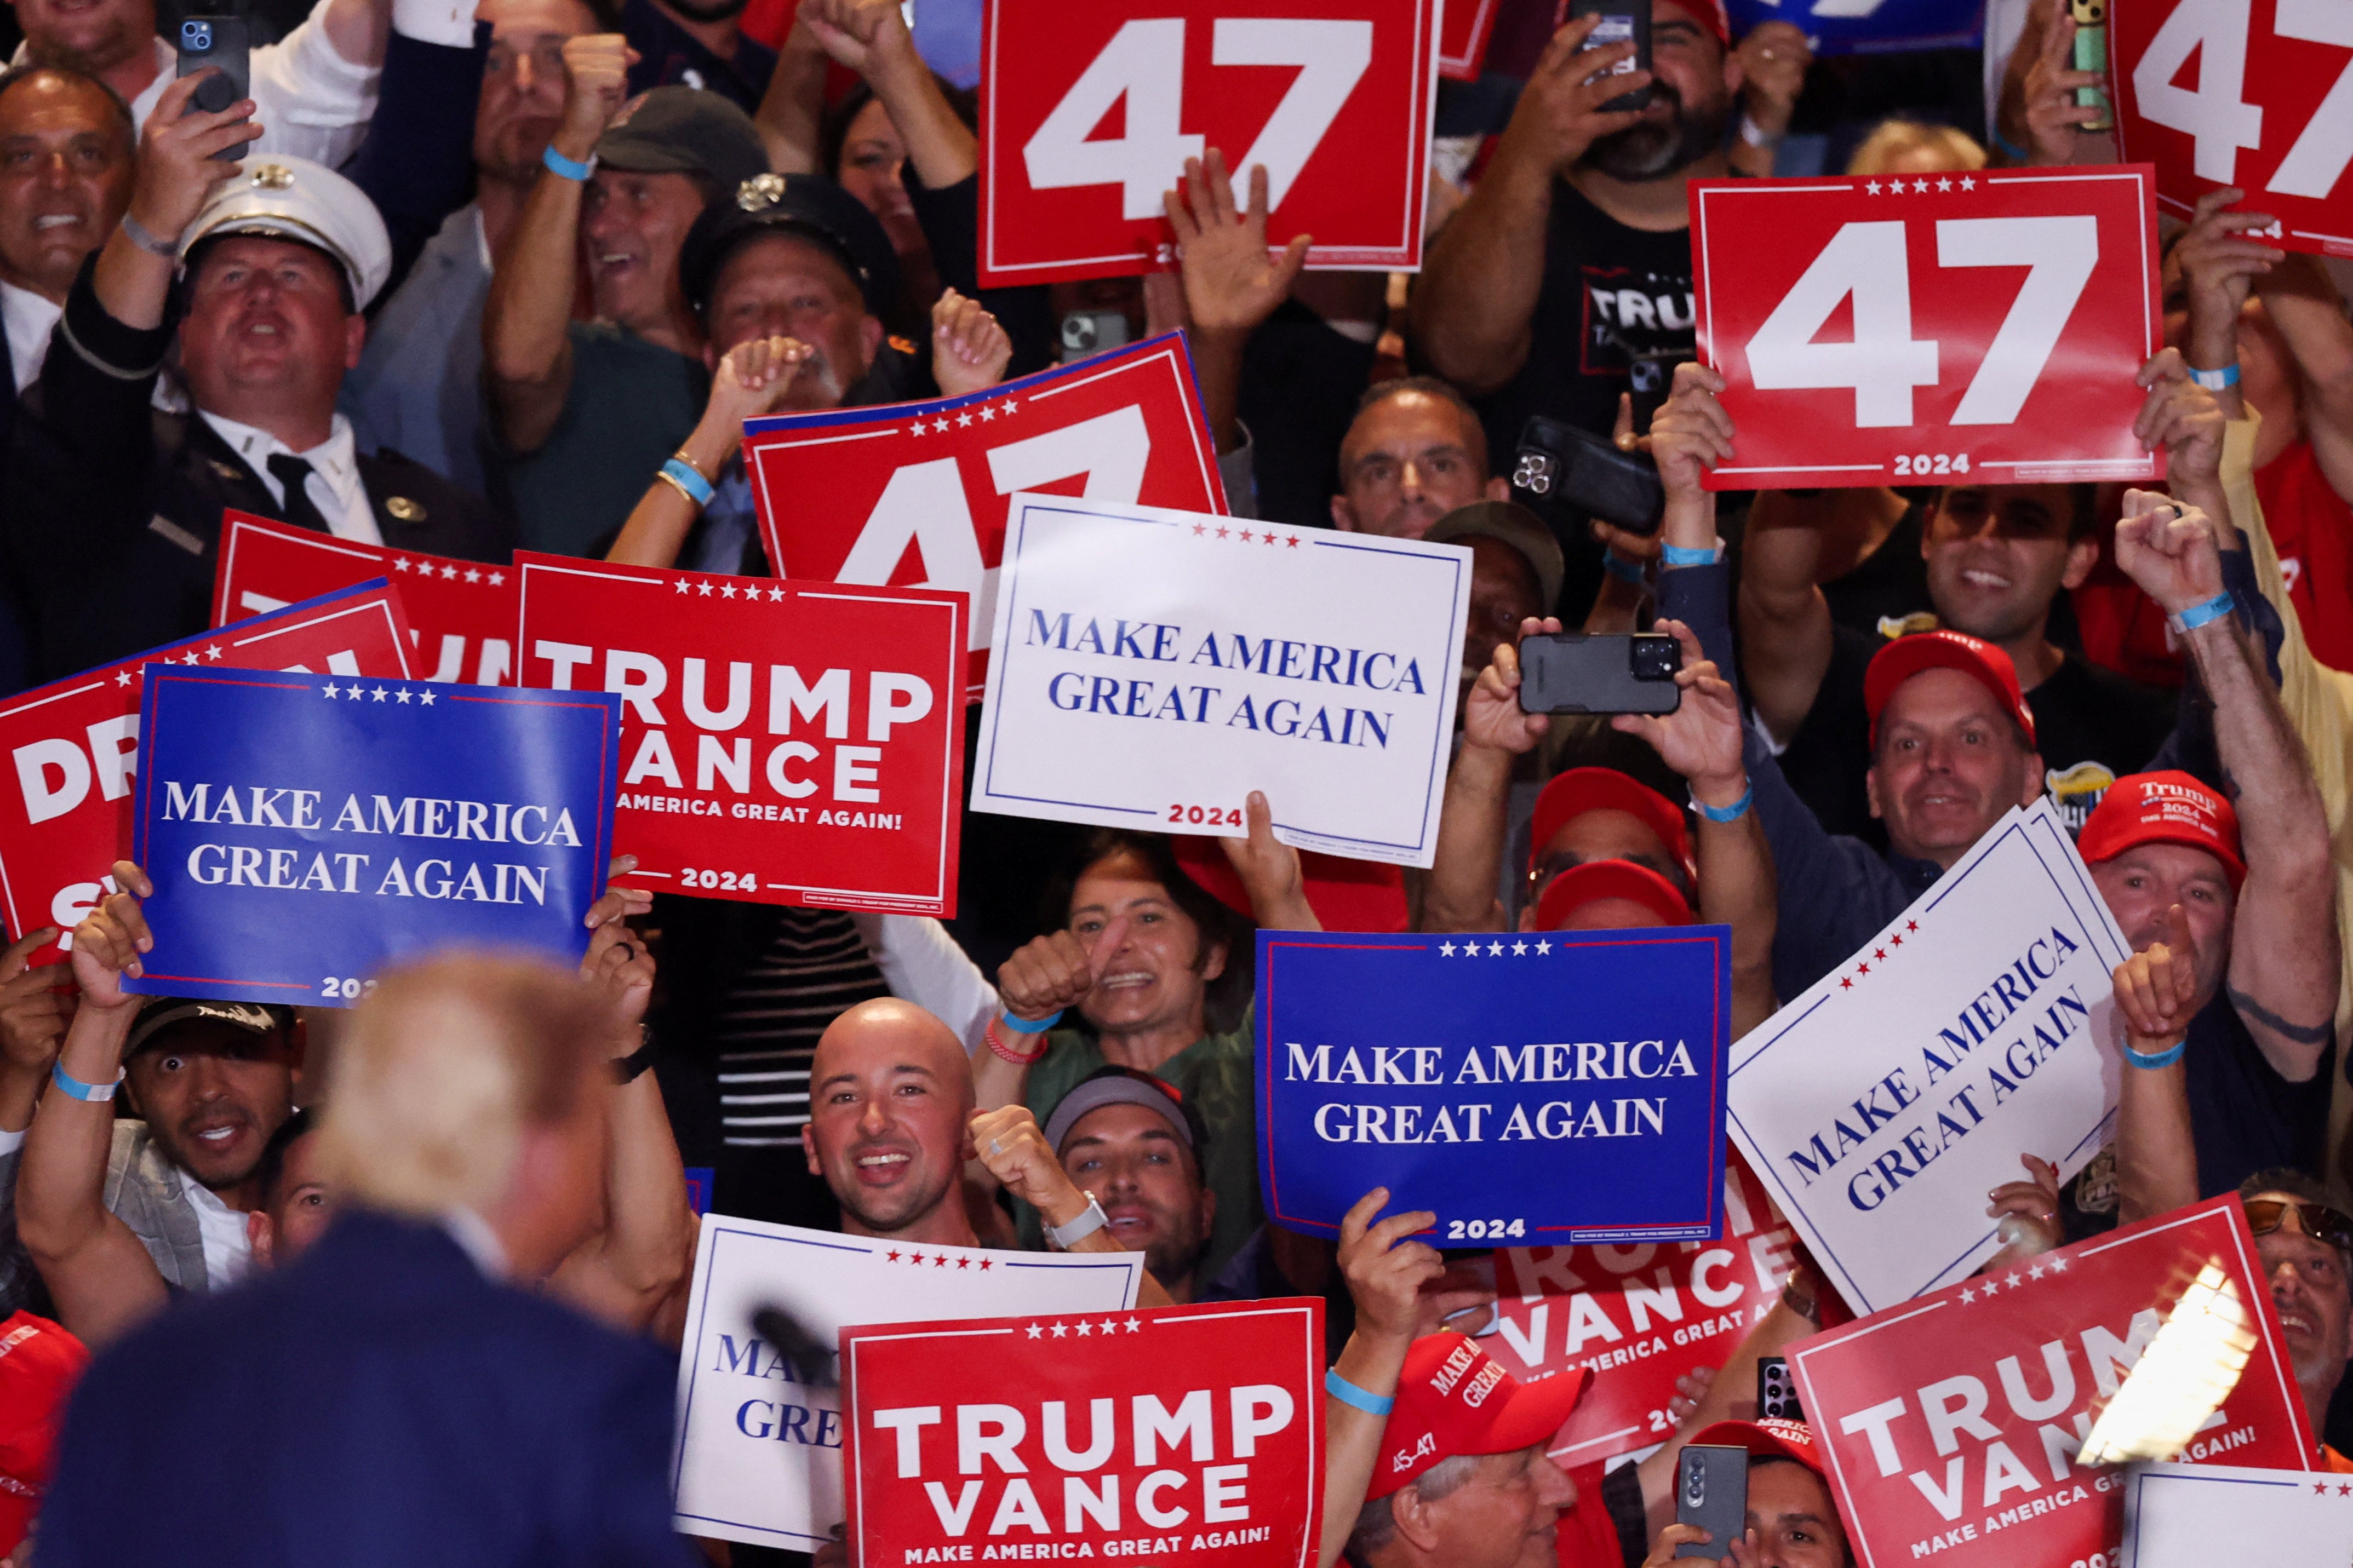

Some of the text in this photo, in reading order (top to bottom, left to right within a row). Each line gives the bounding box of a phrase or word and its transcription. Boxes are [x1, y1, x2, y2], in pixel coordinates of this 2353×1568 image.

[1022, 18, 1373, 220] 47
[2133, 0, 2353, 199] 47
[1590, 288, 1695, 331] TRU
[1745, 215, 2099, 428] 47
[1894, 453, 1970, 475] 2024
[1024, 608, 1427, 695] MAKE AMERICA
[534, 639, 934, 742] TRUMP
[1047, 671, 1394, 749] GREAT AGAIN
[619, 727, 881, 804] ANCE
[161, 780, 583, 847] MAKE AMERICA
[616, 793, 902, 830] AMERICA GREAT AGAIN!
[1167, 804, 1243, 827] 2024
[2139, 782, 2217, 811] Trump
[2162, 802, 2201, 820] 2024
[187, 842, 550, 906] GREAT AGAIN
[682, 868, 757, 893] 2024
[321, 977, 379, 998] 202
[1284, 1039, 1698, 1085] MAKE AMERICA
[1785, 926, 2079, 1187] MAKE AMERICA
[1314, 1098, 1667, 1144] GREAT AGAIN
[1847, 1084, 1986, 1211] GREAT
[1989, 984, 2091, 1106] AGAIN
[1448, 1219, 1525, 1239] 2024
[1498, 1228, 1793, 1368] VANCE
[1673, 1309, 1743, 1346] GREAT
[1430, 1346, 1474, 1397] MAKE
[1840, 1308, 2163, 1479] TRUM
[736, 1399, 843, 1449] GRE
[874, 1384, 1294, 1479] TRUMP
[1768, 1427, 1812, 1445] GAIN
[924, 1463, 1249, 1537] VANCE
[1910, 1523, 1977, 1560] MAKE
[1985, 1485, 2090, 1533] AMERICA
[904, 1526, 1269, 1565] MAKE AMERICA GREAT AGAIN!
